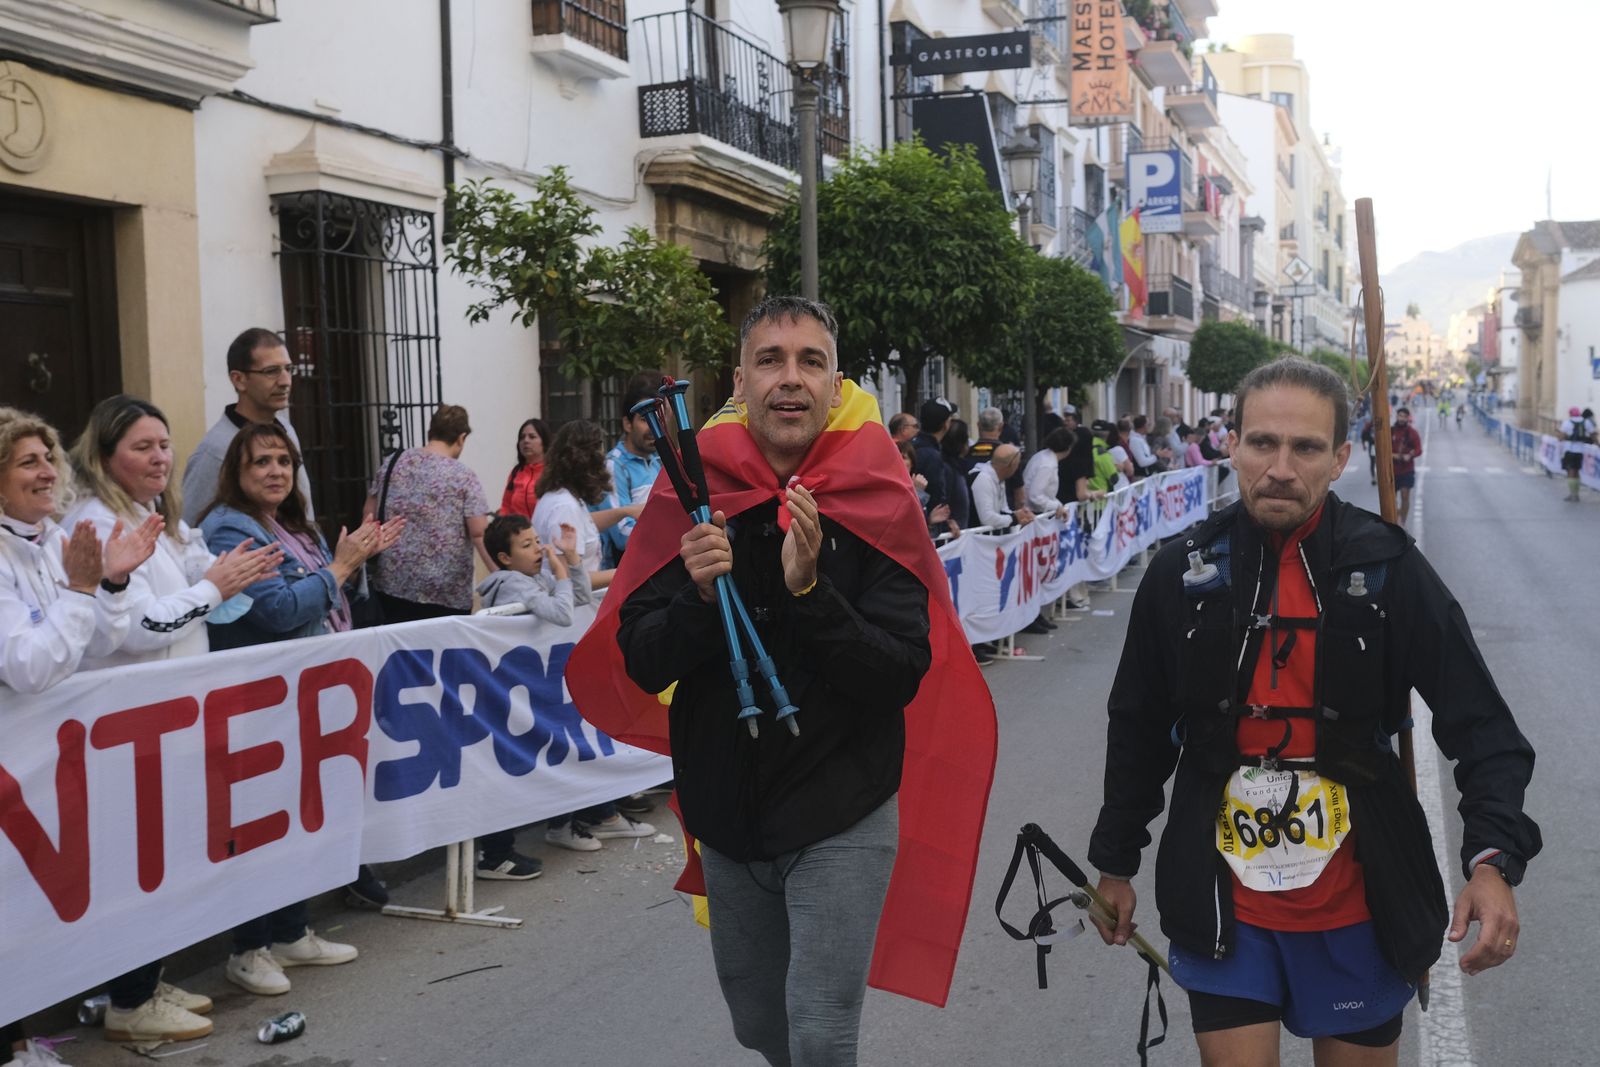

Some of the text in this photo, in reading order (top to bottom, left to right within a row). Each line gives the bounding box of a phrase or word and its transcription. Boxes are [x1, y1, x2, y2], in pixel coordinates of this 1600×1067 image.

[1073, 0, 1091, 71] MAES
[1097, 0, 1115, 71] HOTE
[918, 44, 1023, 62] GASTROBAR
[1246, 785, 1288, 797] Fundaci
[1267, 773, 1292, 783] Unica
[1234, 798, 1323, 848] 6861
[1333, 807, 1342, 835] EDICI
